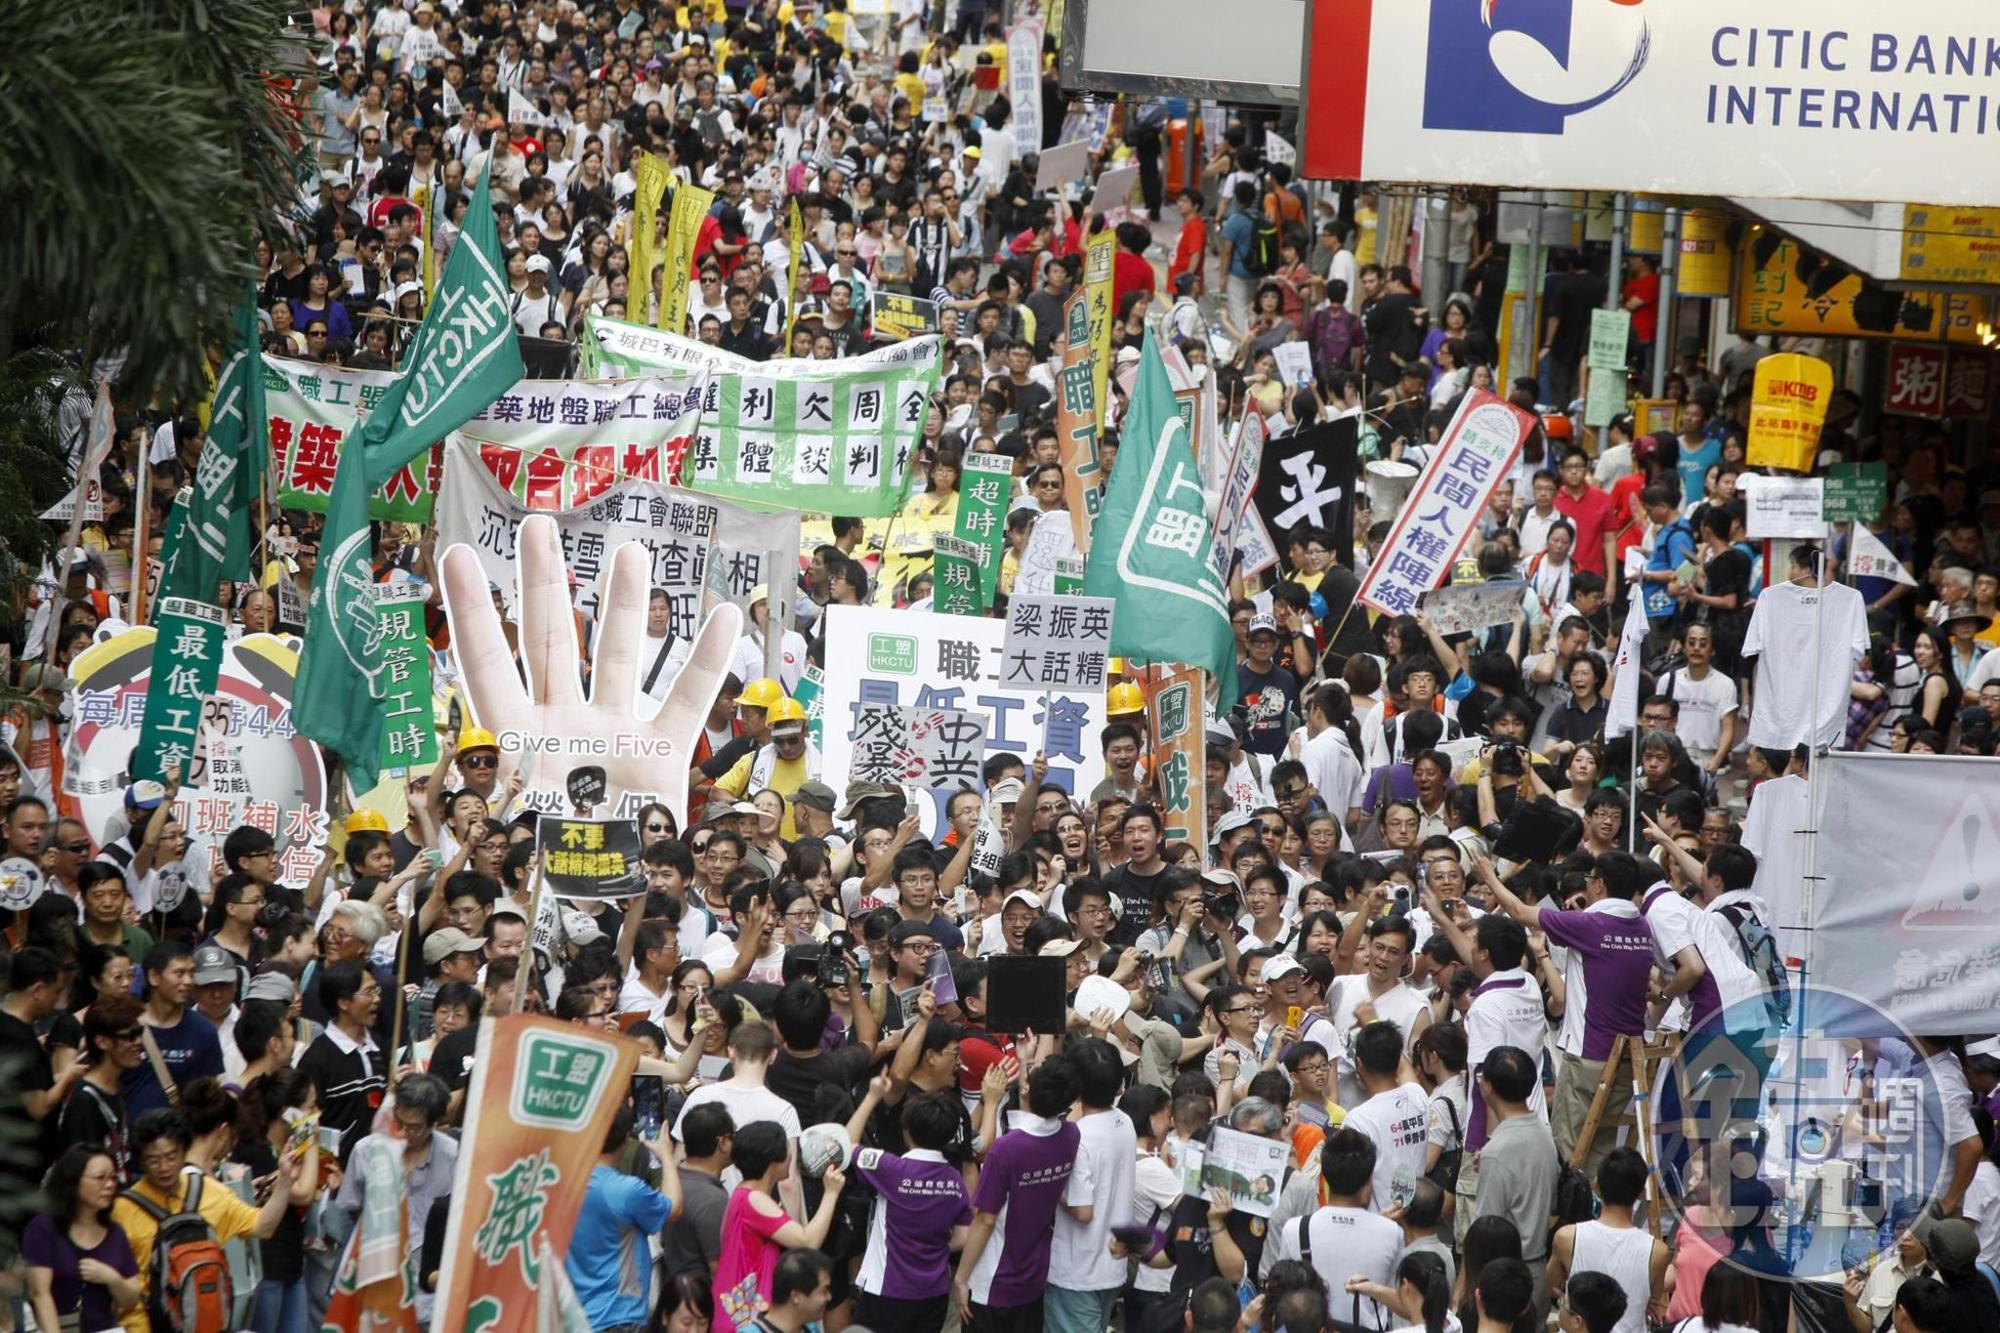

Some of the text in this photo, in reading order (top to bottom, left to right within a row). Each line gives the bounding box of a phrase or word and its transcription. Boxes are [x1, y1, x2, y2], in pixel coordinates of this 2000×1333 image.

[1711, 26, 2000, 77] CITIC BANK
[1707, 84, 2000, 135] INTERNATI
[1784, 380, 1818, 402] KMB
[1891, 356, 1939, 405] 粥
[1273, 450, 1341, 530] 平
[586, 492, 719, 537] 港職工會聯盟
[1372, 447, 1492, 617] 民間人權陣線
[1012, 604, 1110, 641] 梁振英
[1250, 615, 1277, 627] BLACK
[872, 655, 913, 669] HKCTU
[875, 640, 911, 656] 工盟
[378, 610, 427, 759] 規管工時
[1007, 649, 1106, 685] 大話精
[155, 624, 210, 775] 最低工資
[500, 731, 672, 757] Give me Five
[560, 822, 605, 849] 不要
[536, 1048, 599, 1086] 工盟
[526, 1086, 587, 1113] HKCTU
